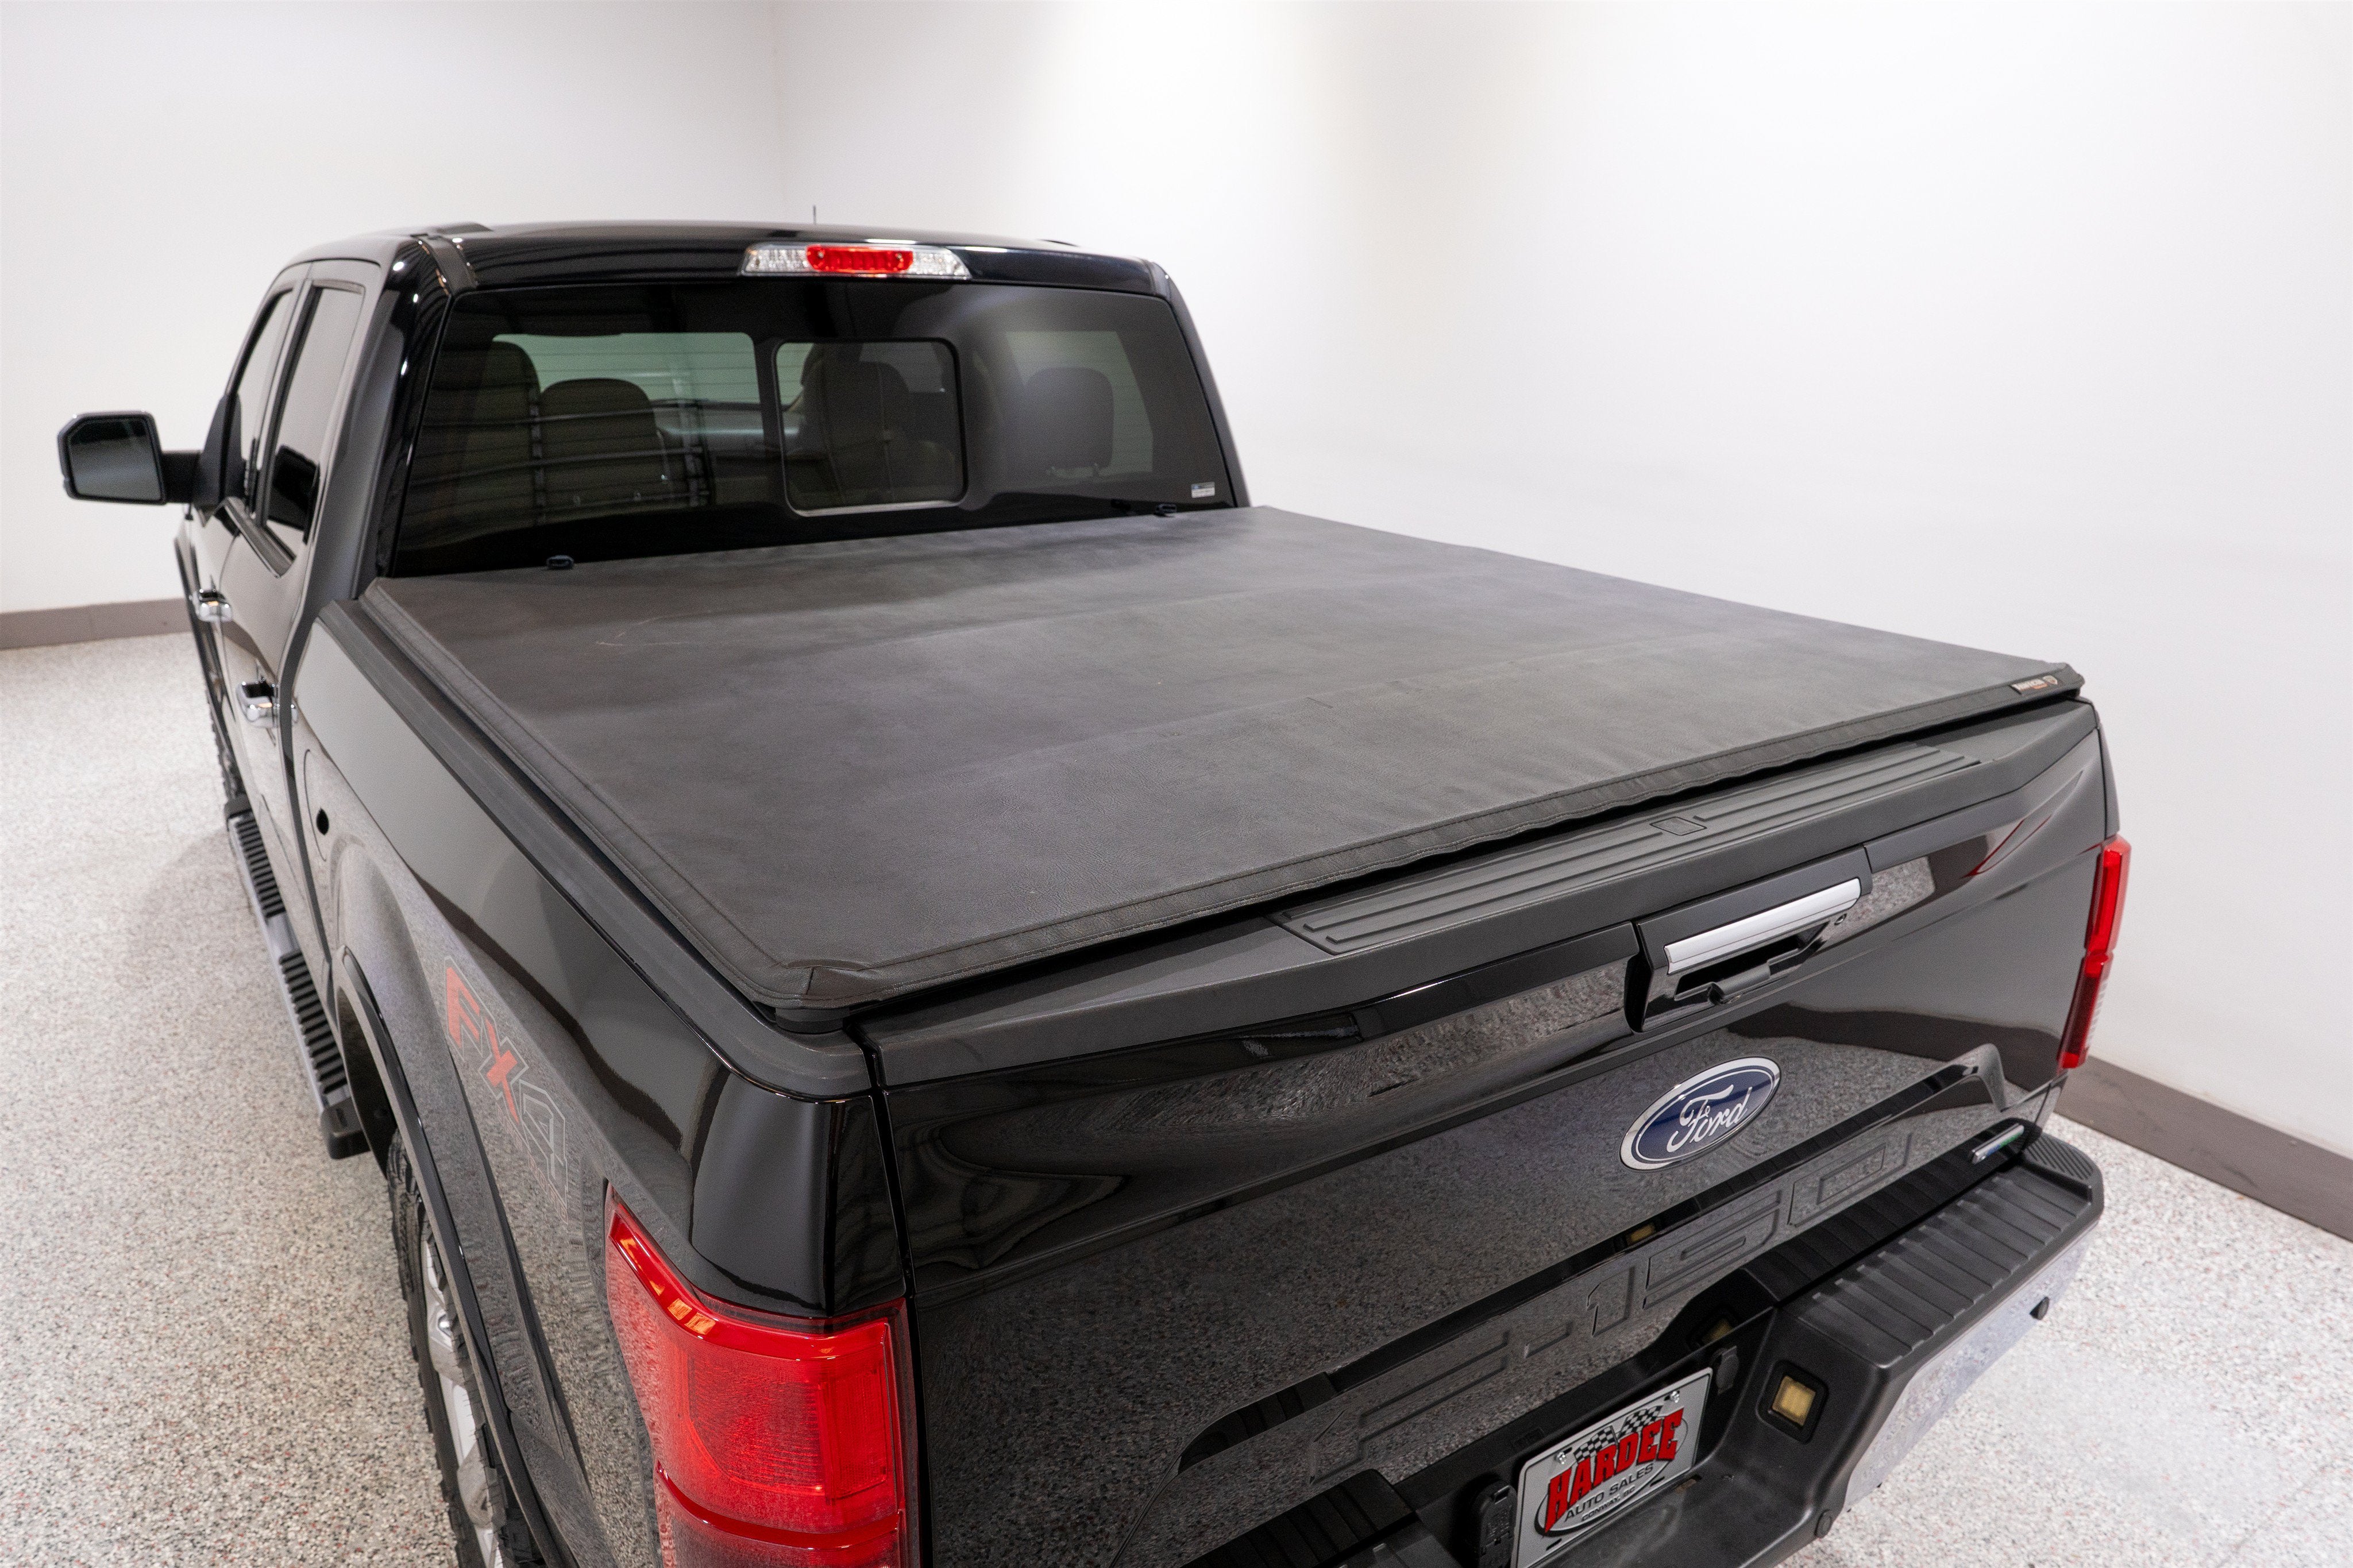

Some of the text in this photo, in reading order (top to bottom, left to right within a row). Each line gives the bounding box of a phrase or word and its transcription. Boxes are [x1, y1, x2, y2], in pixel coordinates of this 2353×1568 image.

[443, 955, 569, 1211] FX4
[1666, 1084, 1753, 1153] Ford
[1307, 1128, 1912, 1485] F-150
[1545, 1407, 1684, 1533] HARDEE
[1564, 1463, 1654, 1522] AUTO SALES
